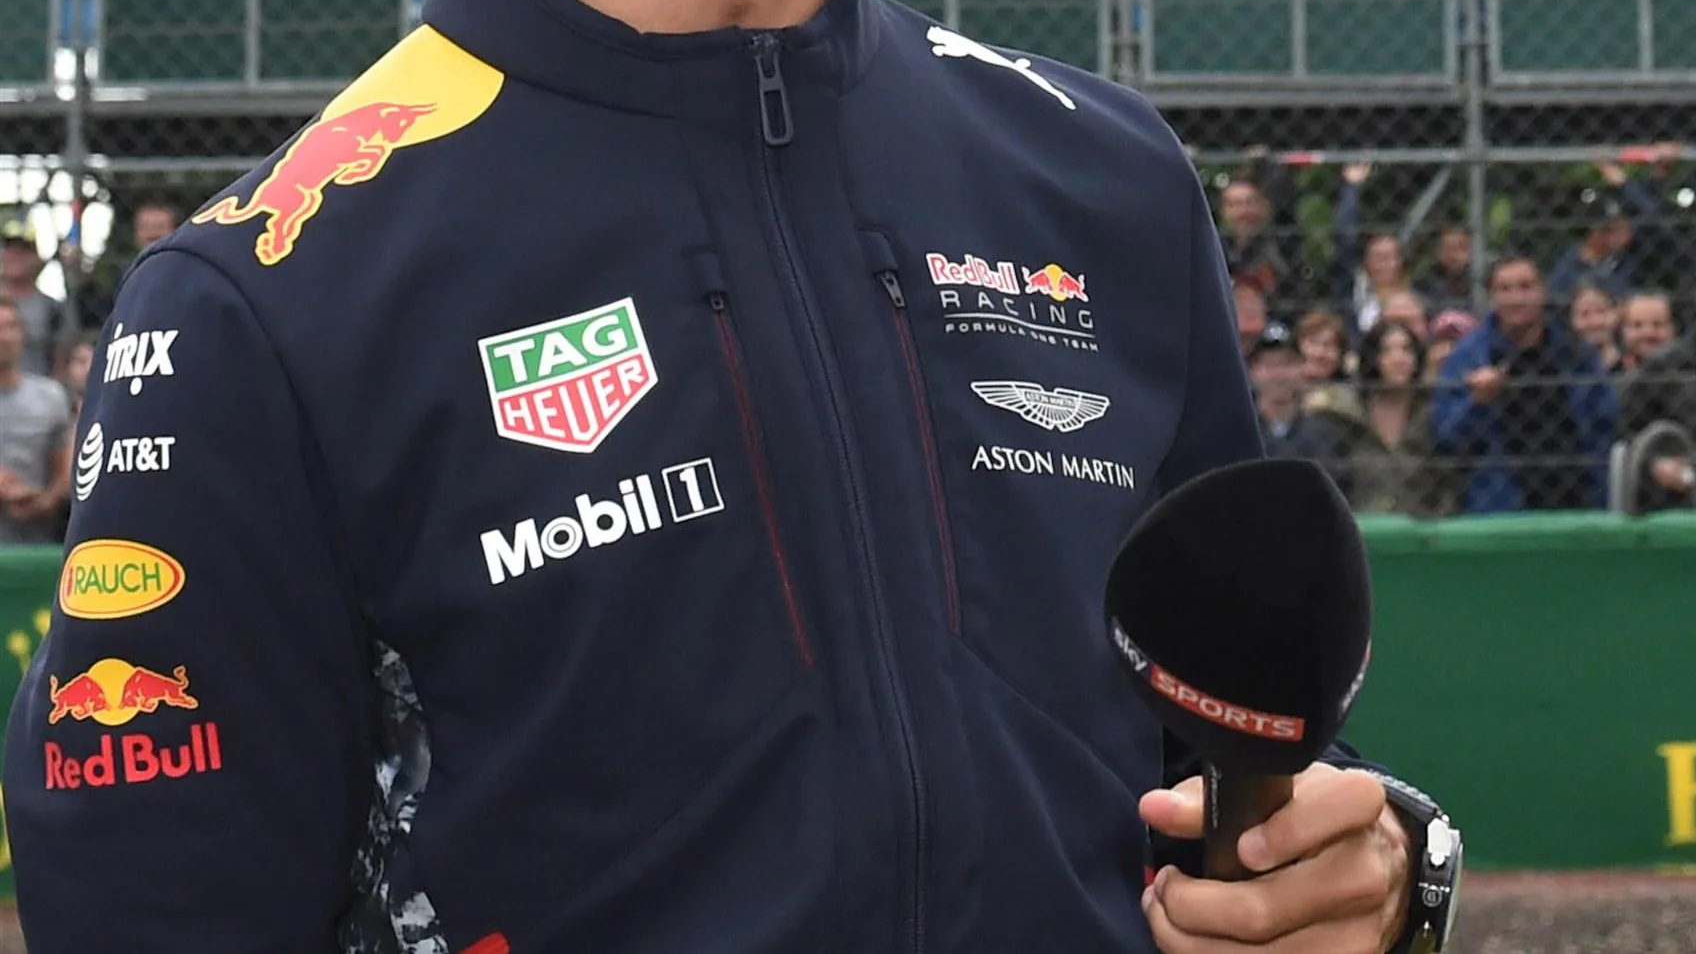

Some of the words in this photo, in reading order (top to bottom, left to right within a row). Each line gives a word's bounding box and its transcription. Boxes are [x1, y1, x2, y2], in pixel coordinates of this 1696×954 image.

[940, 290, 1095, 329] RACING
[945, 322, 1026, 336] FORMULA
[103, 322, 179, 396] ITRIX
[493, 314, 628, 383] TAG
[503, 359, 646, 441] HEUER
[106, 437, 176, 473] AT&T
[972, 445, 1054, 475] ASTON
[1062, 453, 1135, 490] MARTIN
[480, 474, 662, 585] Mobil
[72, 562, 163, 595] RAUCH
[1156, 672, 1296, 738] SPORTS
[45, 734, 115, 790] Red
[122, 722, 222, 783] Bull
